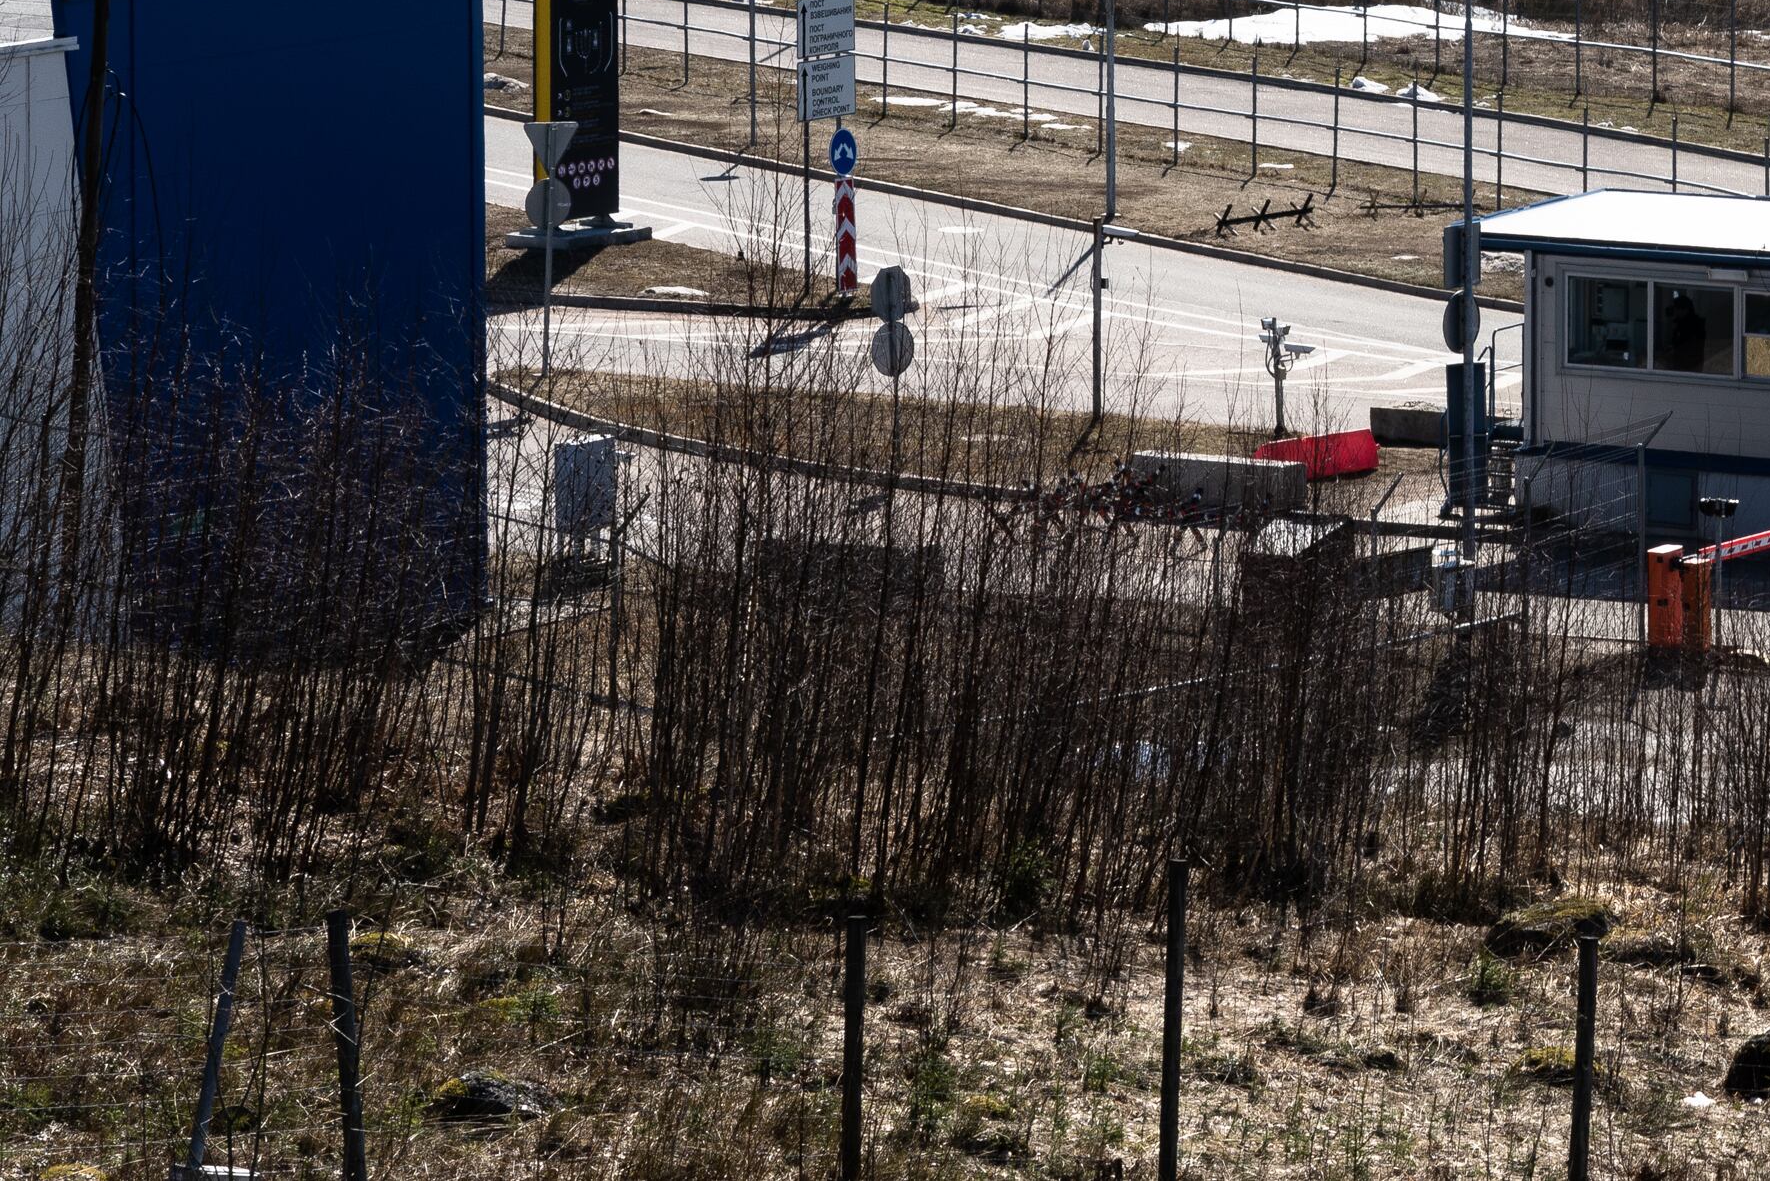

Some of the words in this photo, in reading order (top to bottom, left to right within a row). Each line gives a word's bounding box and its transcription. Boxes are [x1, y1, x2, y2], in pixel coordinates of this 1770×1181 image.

[810, 0, 825, 9] ПОСТ
[810, 5, 852, 20] ВЗВЕШИВАНИЯ
[810, 23, 825, 33] ПОСТ
[810, 29, 853, 44] ПОГРАНИЧНОГО
[809, 41, 839, 55] КОНТРОЛЯ
[811, 61, 840, 72] WEIGHING
[811, 73, 829, 84] POINT
[812, 84, 844, 97] BOUNDARY
[812, 95, 840, 108] CONTROL
[812, 108, 831, 117] CHECK
[832, 104, 850, 114] POINT
